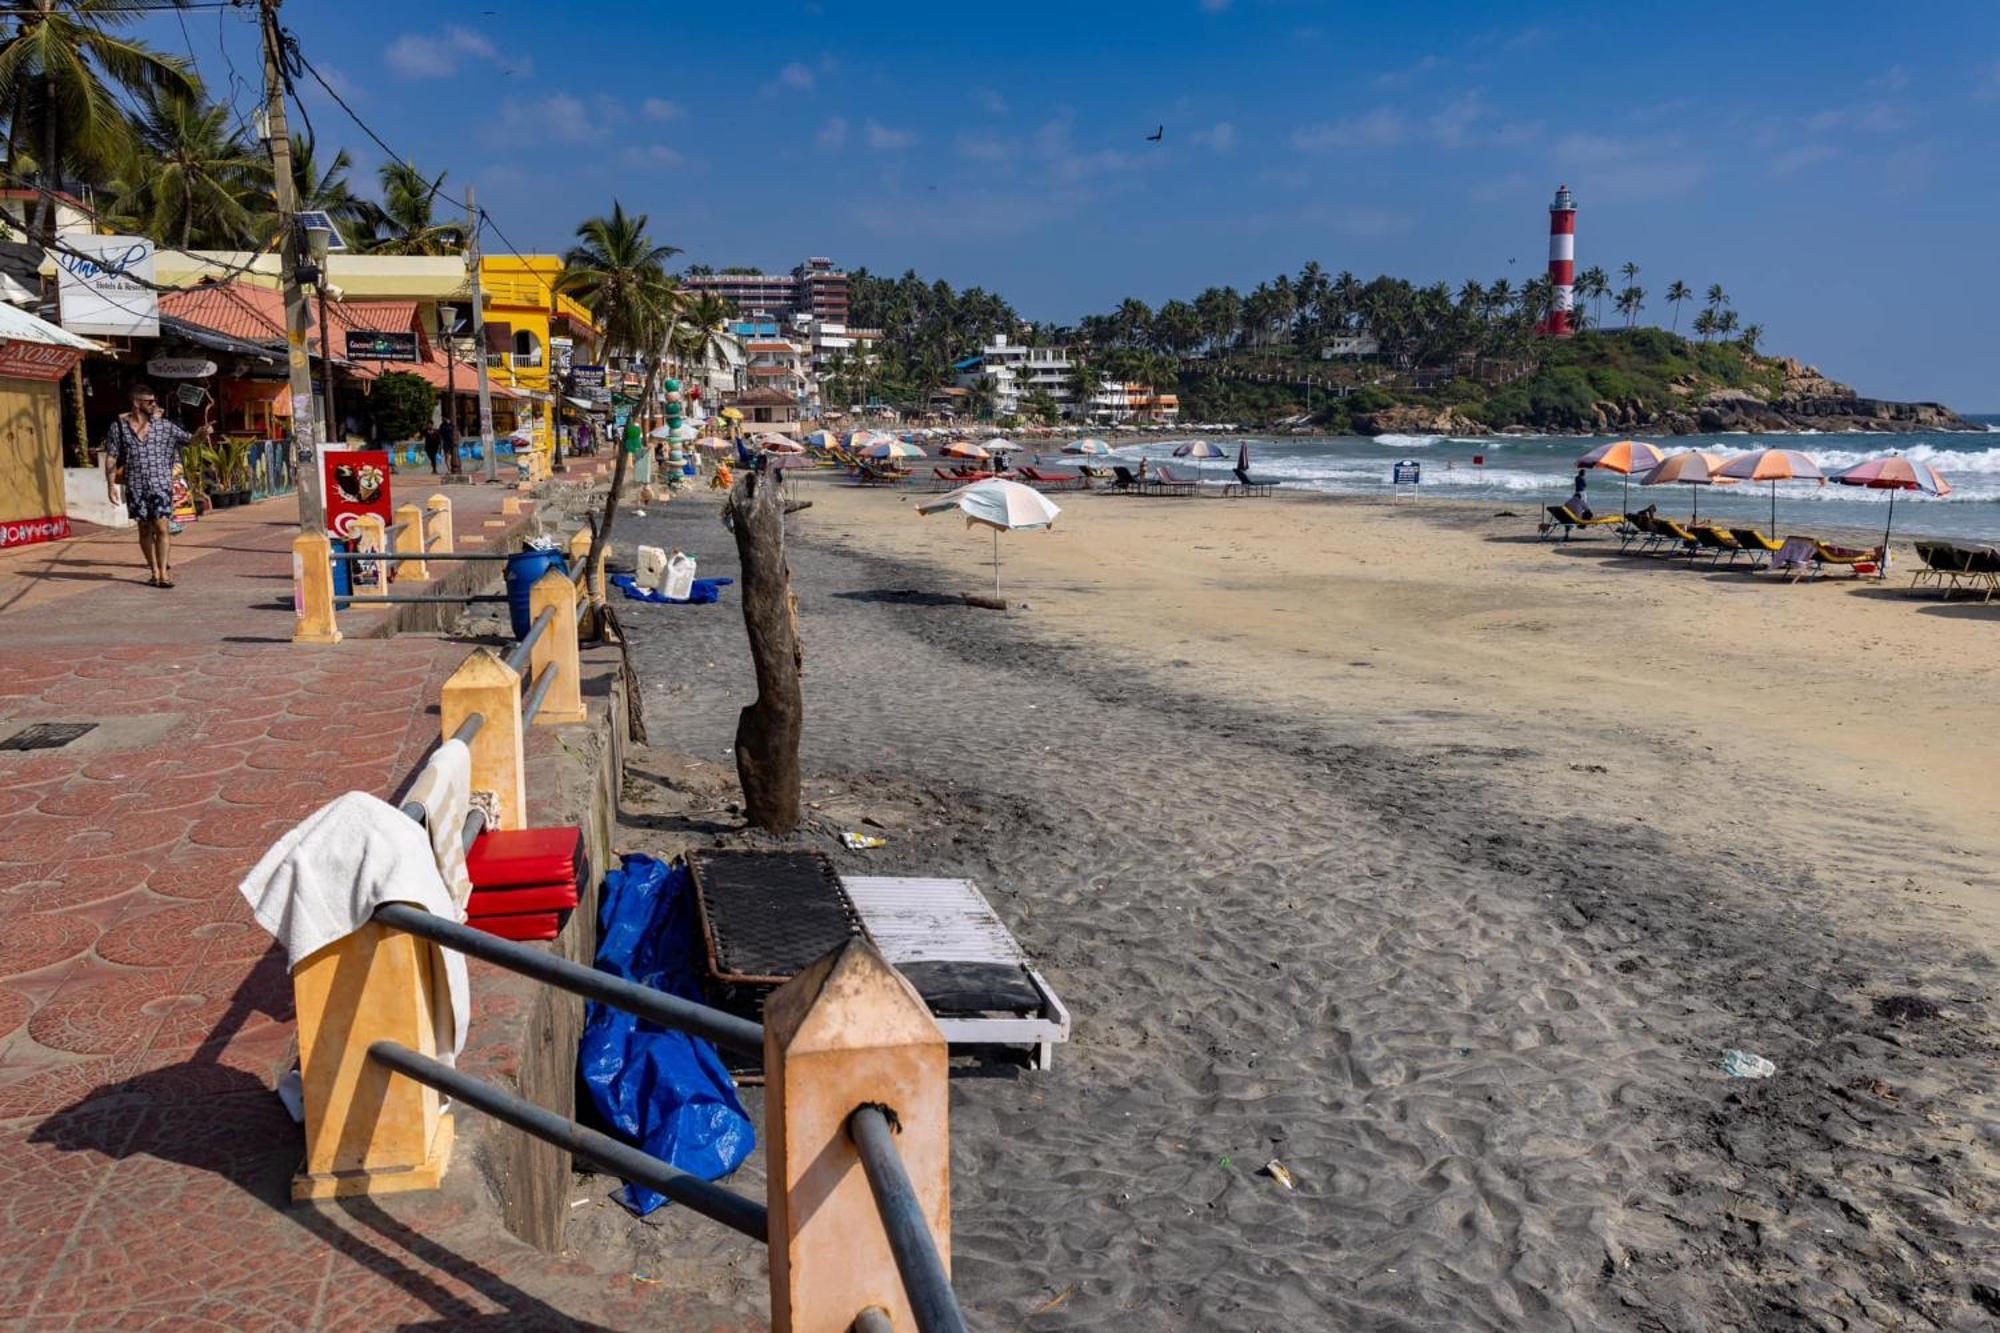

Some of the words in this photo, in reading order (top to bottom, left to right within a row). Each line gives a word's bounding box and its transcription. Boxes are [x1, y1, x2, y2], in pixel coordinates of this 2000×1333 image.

[96, 281, 116, 291] Hotels
[117, 282, 123, 290] &
[15, 344, 75, 367] NOBLE
